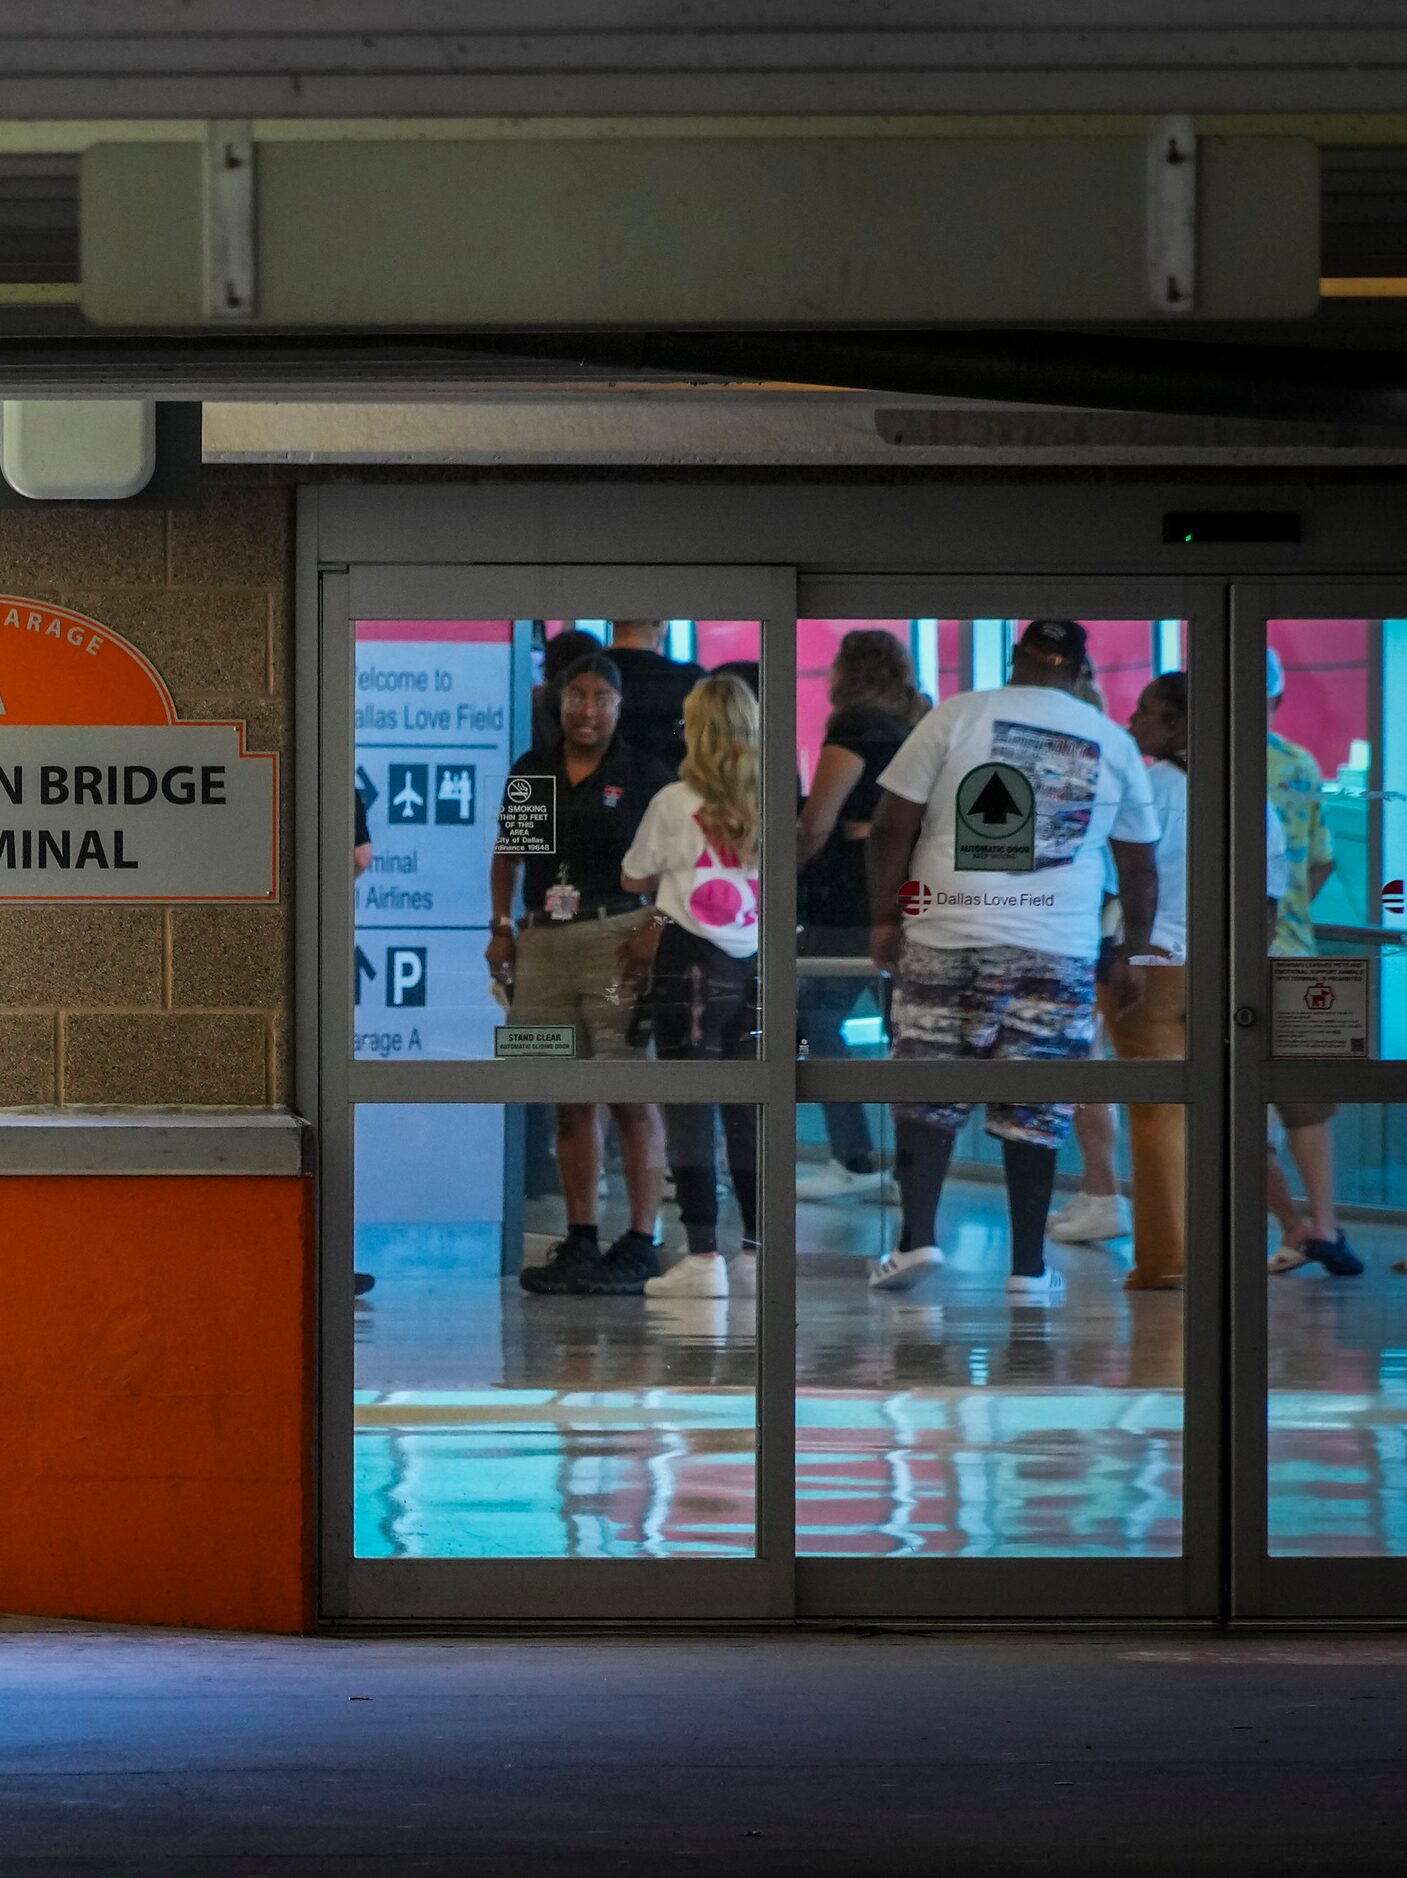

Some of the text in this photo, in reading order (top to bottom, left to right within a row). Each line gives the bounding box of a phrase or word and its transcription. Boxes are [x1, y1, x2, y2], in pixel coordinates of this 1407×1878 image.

[356, 667, 452, 692] elcome to
[355, 703, 504, 731] allas Love Field
[40, 765, 226, 805] BRIDGE
[507, 805, 547, 813] SMOKING
[522, 836, 544, 844] Dallas
[369, 849, 417, 873] minal
[366, 885, 433, 910] Airlines
[936, 892, 1055, 907] Dallas Love Field
[393, 951, 422, 1005] P
[408, 1027, 422, 1050] A
[508, 1033, 562, 1041] STAND CLEAR
